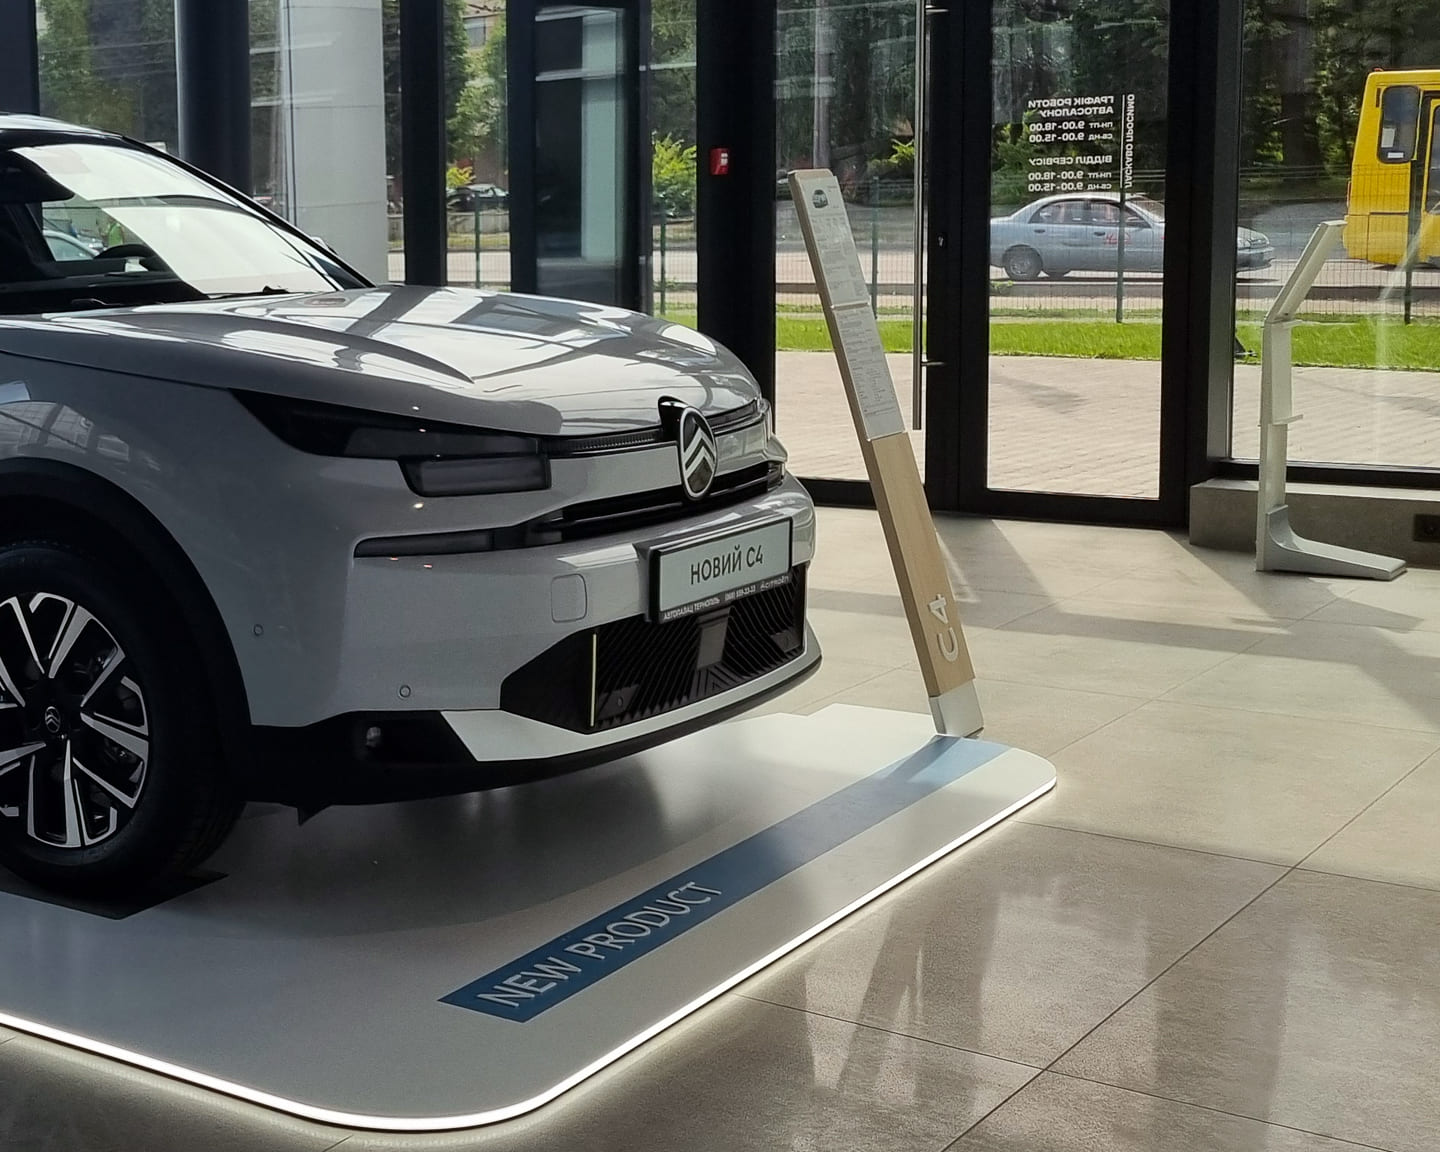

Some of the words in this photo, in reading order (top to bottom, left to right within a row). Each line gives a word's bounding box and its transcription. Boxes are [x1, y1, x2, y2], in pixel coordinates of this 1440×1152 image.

[690, 545, 742, 585] НОВИЙ
[928, 593, 960, 662] C4
[476, 956, 583, 1009] NEW
[565, 881, 723, 961] PRODUCT
